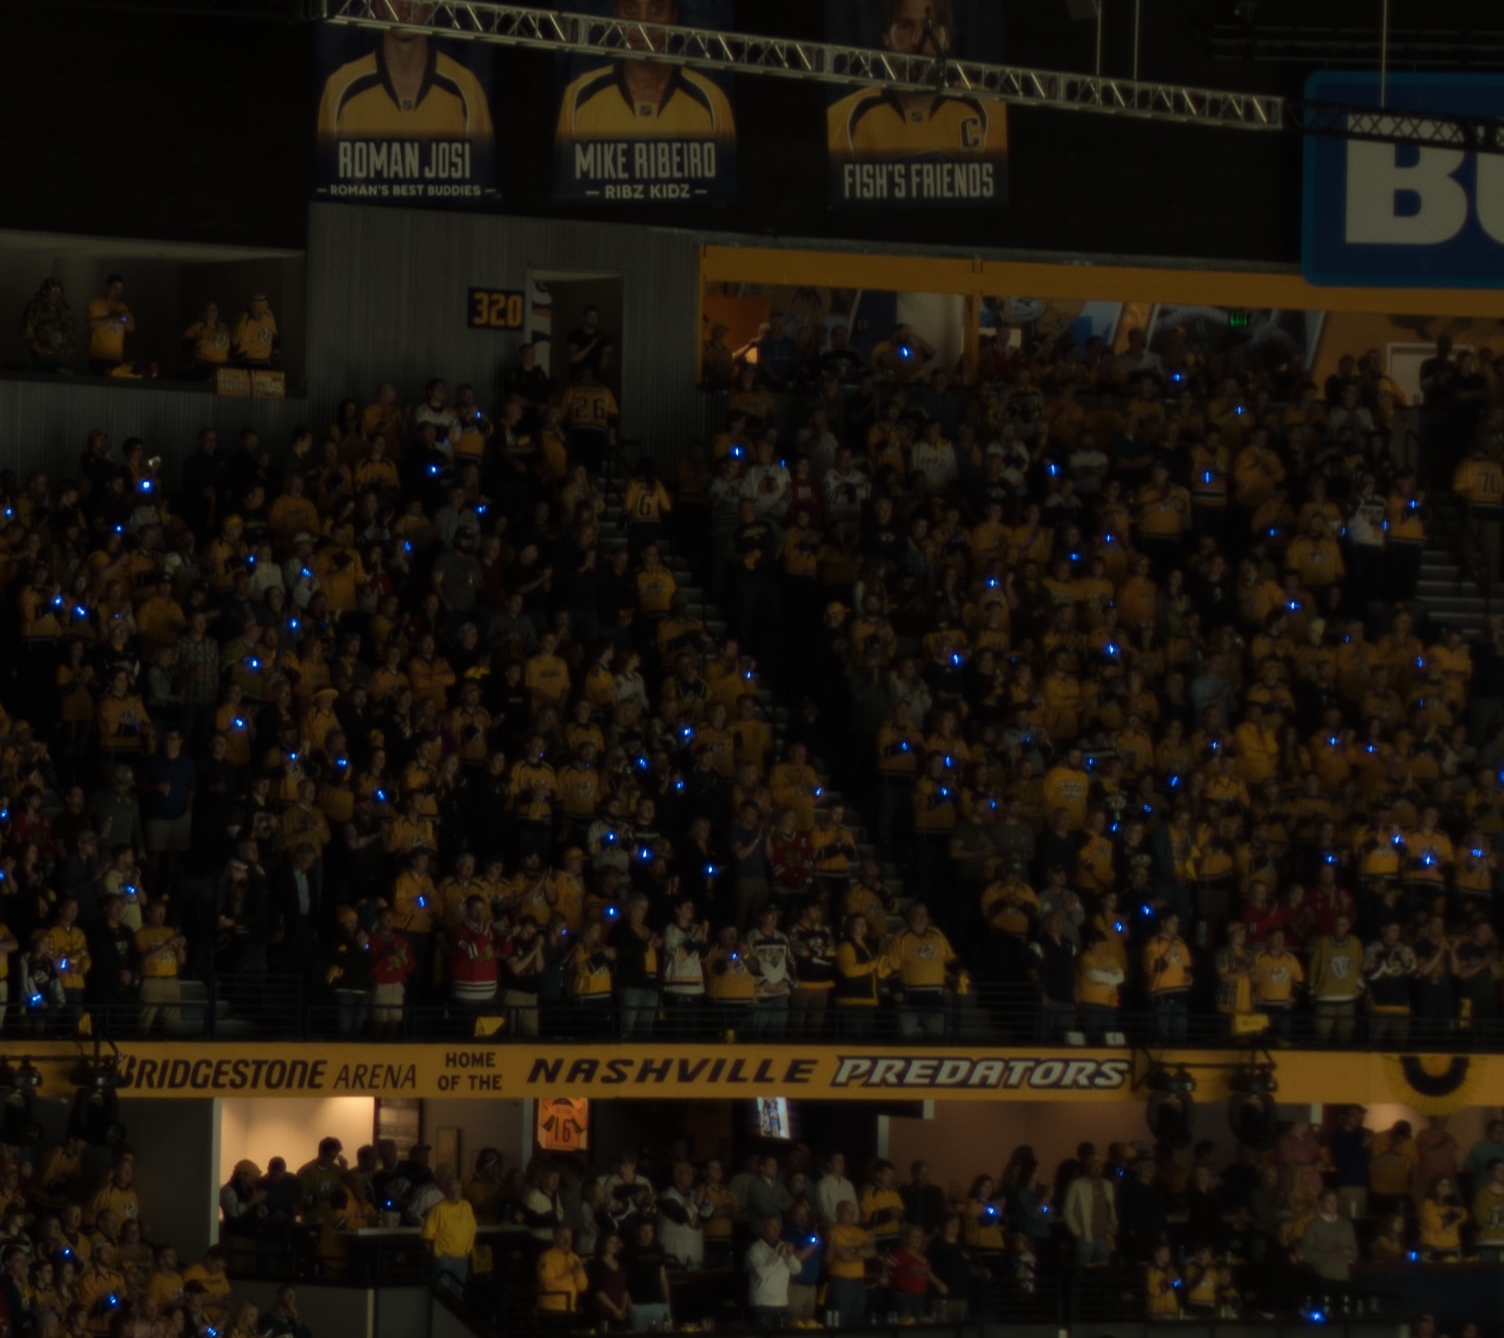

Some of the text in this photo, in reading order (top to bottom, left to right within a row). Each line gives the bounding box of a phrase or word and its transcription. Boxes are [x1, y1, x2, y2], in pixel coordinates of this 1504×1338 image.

[338, 140, 470, 180] ROMAN JOSI
[575, 142, 716, 180] MIKE RIBEIRO
[330, 184, 481, 198] ROMAN'S BEST BUDDIES
[605, 184, 690, 199] RIBZ KIDZ
[843, 161, 995, 201] FISH'S FRIENDS
[472, 292, 523, 328] 320
[572, 396, 606, 419] 26
[118, 1053, 416, 1091] BRIDGESTONE ARENA
[445, 1051, 496, 1068] HOME
[526, 1056, 1130, 1089] NASHVILLE PREDATORS
[437, 1074, 503, 1091] OF THE
[555, 1117, 571, 1142] 16
